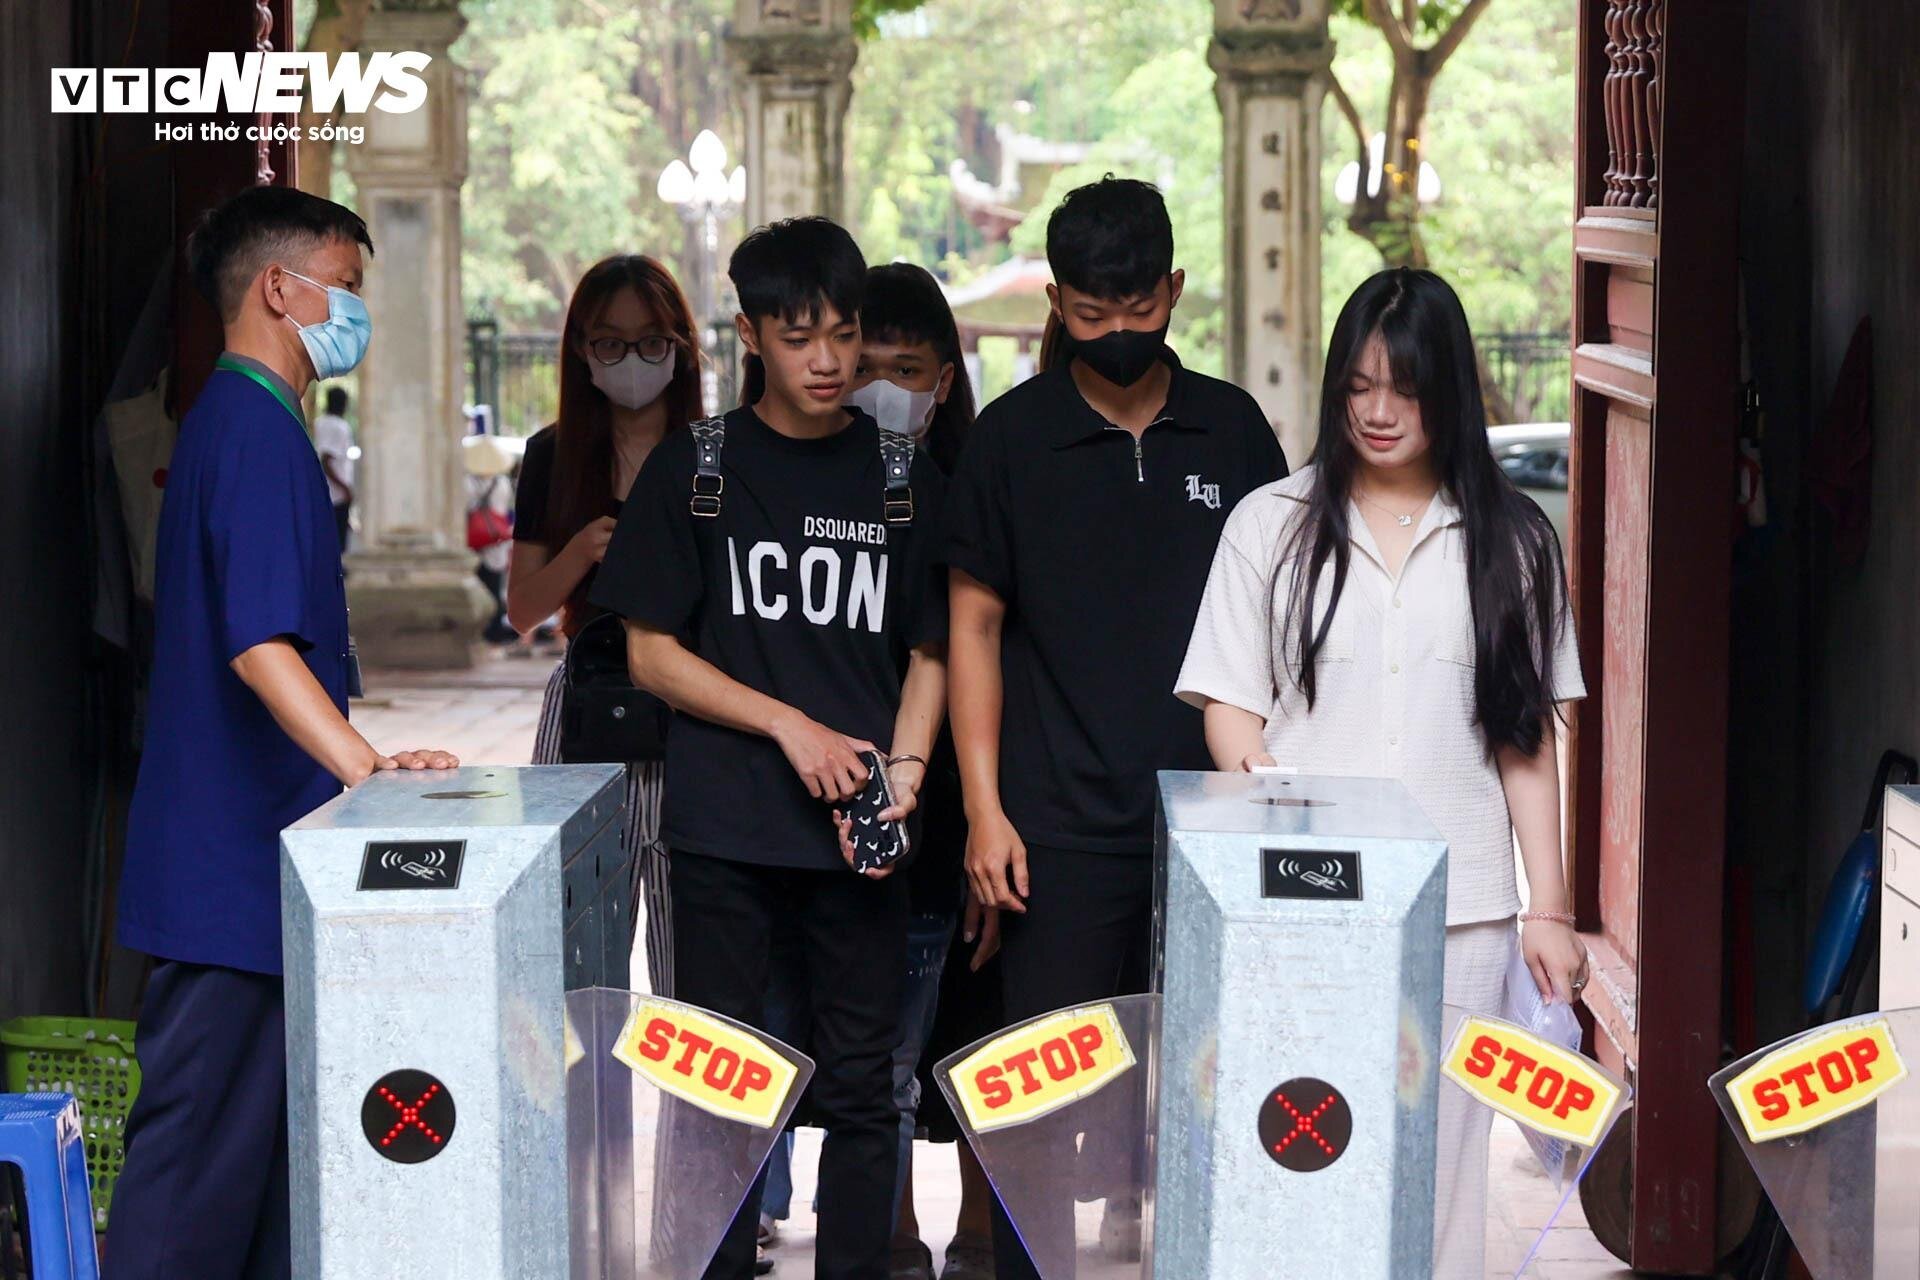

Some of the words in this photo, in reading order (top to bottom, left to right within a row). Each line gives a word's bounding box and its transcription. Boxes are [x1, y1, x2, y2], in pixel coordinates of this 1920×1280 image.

[804, 516, 887, 546] DSQUARED
[727, 536, 889, 633] ICON
[639, 1018, 772, 1100] STOP
[975, 1024, 1103, 1109] STOP
[1464, 1035, 1595, 1120] STOP
[1753, 1038, 1879, 1121] STOP
